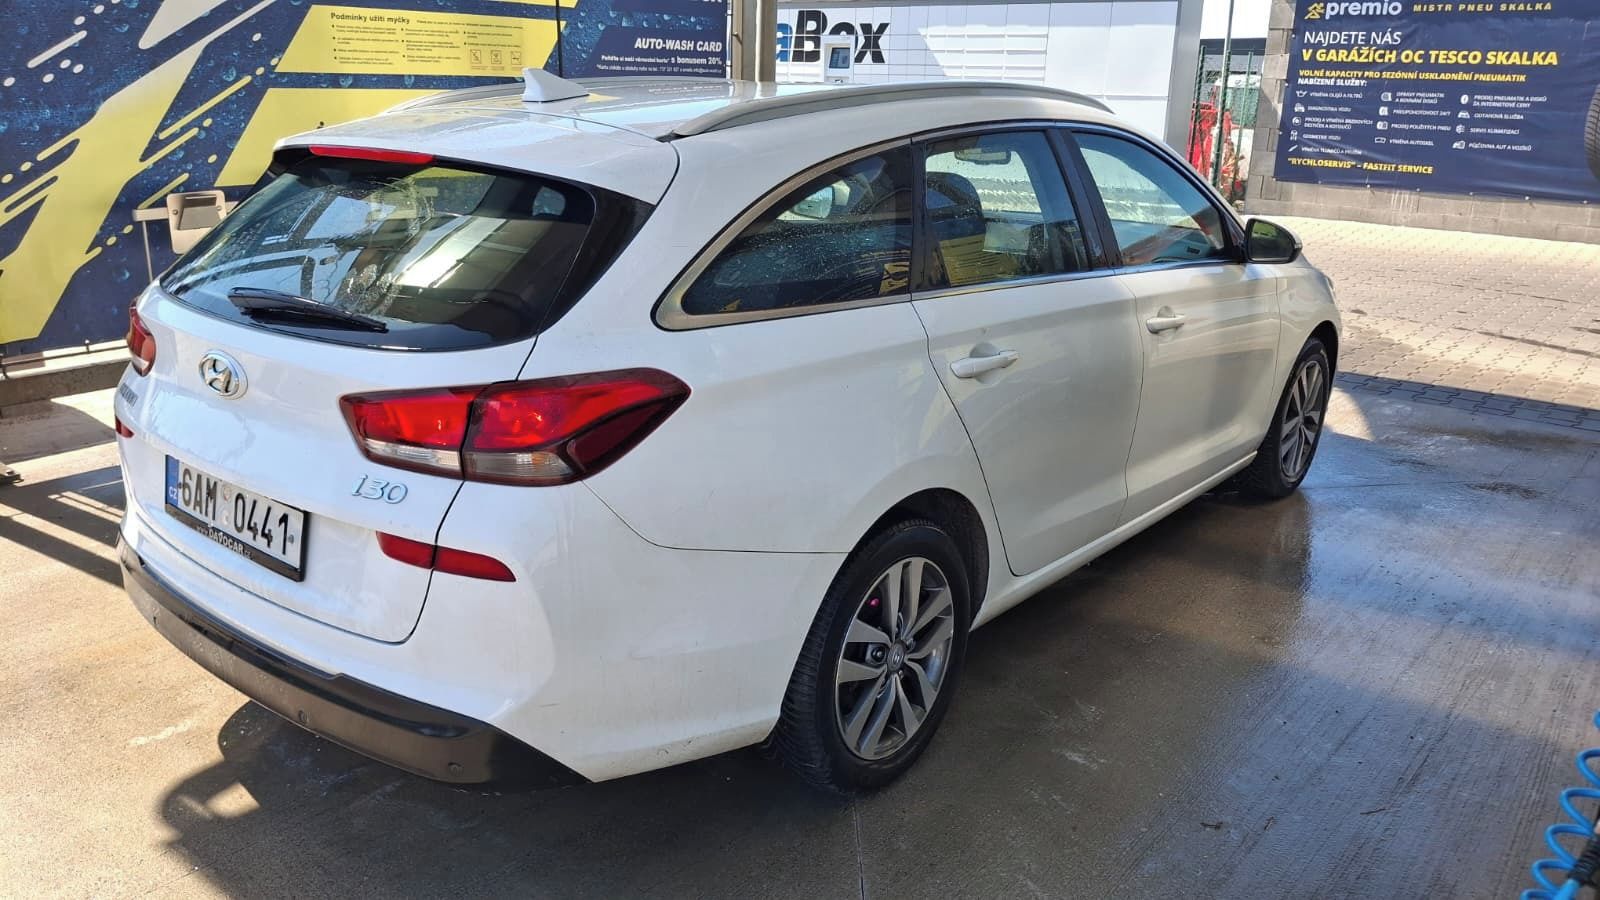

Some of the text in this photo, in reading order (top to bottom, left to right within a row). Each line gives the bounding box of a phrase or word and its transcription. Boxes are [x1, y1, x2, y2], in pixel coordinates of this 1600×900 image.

[1325, 0, 1402, 20] premio
[1413, 3, 1552, 12] MISTR PNEU SKALKA
[1304, 28, 1402, 46] NAJDETE NÁS
[634, 37, 722, 52] AUTO-WASH CARD
[676, 56, 707, 65] bonusem
[708, 57, 722, 65] 20%
[1302, 46, 1558, 65] V GARÁŽÍCH OC TESCO SKALKA
[1298, 77, 1335, 85] NABÍZENÉ
[1299, 69, 1324, 77] VOLNÉ
[1382, 71, 1417, 79] SEZÓNNÍ
[1419, 72, 1472, 81] USKLADNĚNÍ
[1474, 74, 1526, 82] PNEUMATIK
[1362, 162, 1396, 172] FASTFIT
[1397, 165, 1434, 174] SERVICE
[168, 486, 178, 499] CZ
[351, 473, 409, 504] i30
[182, 468, 289, 555] 6AM 0441
